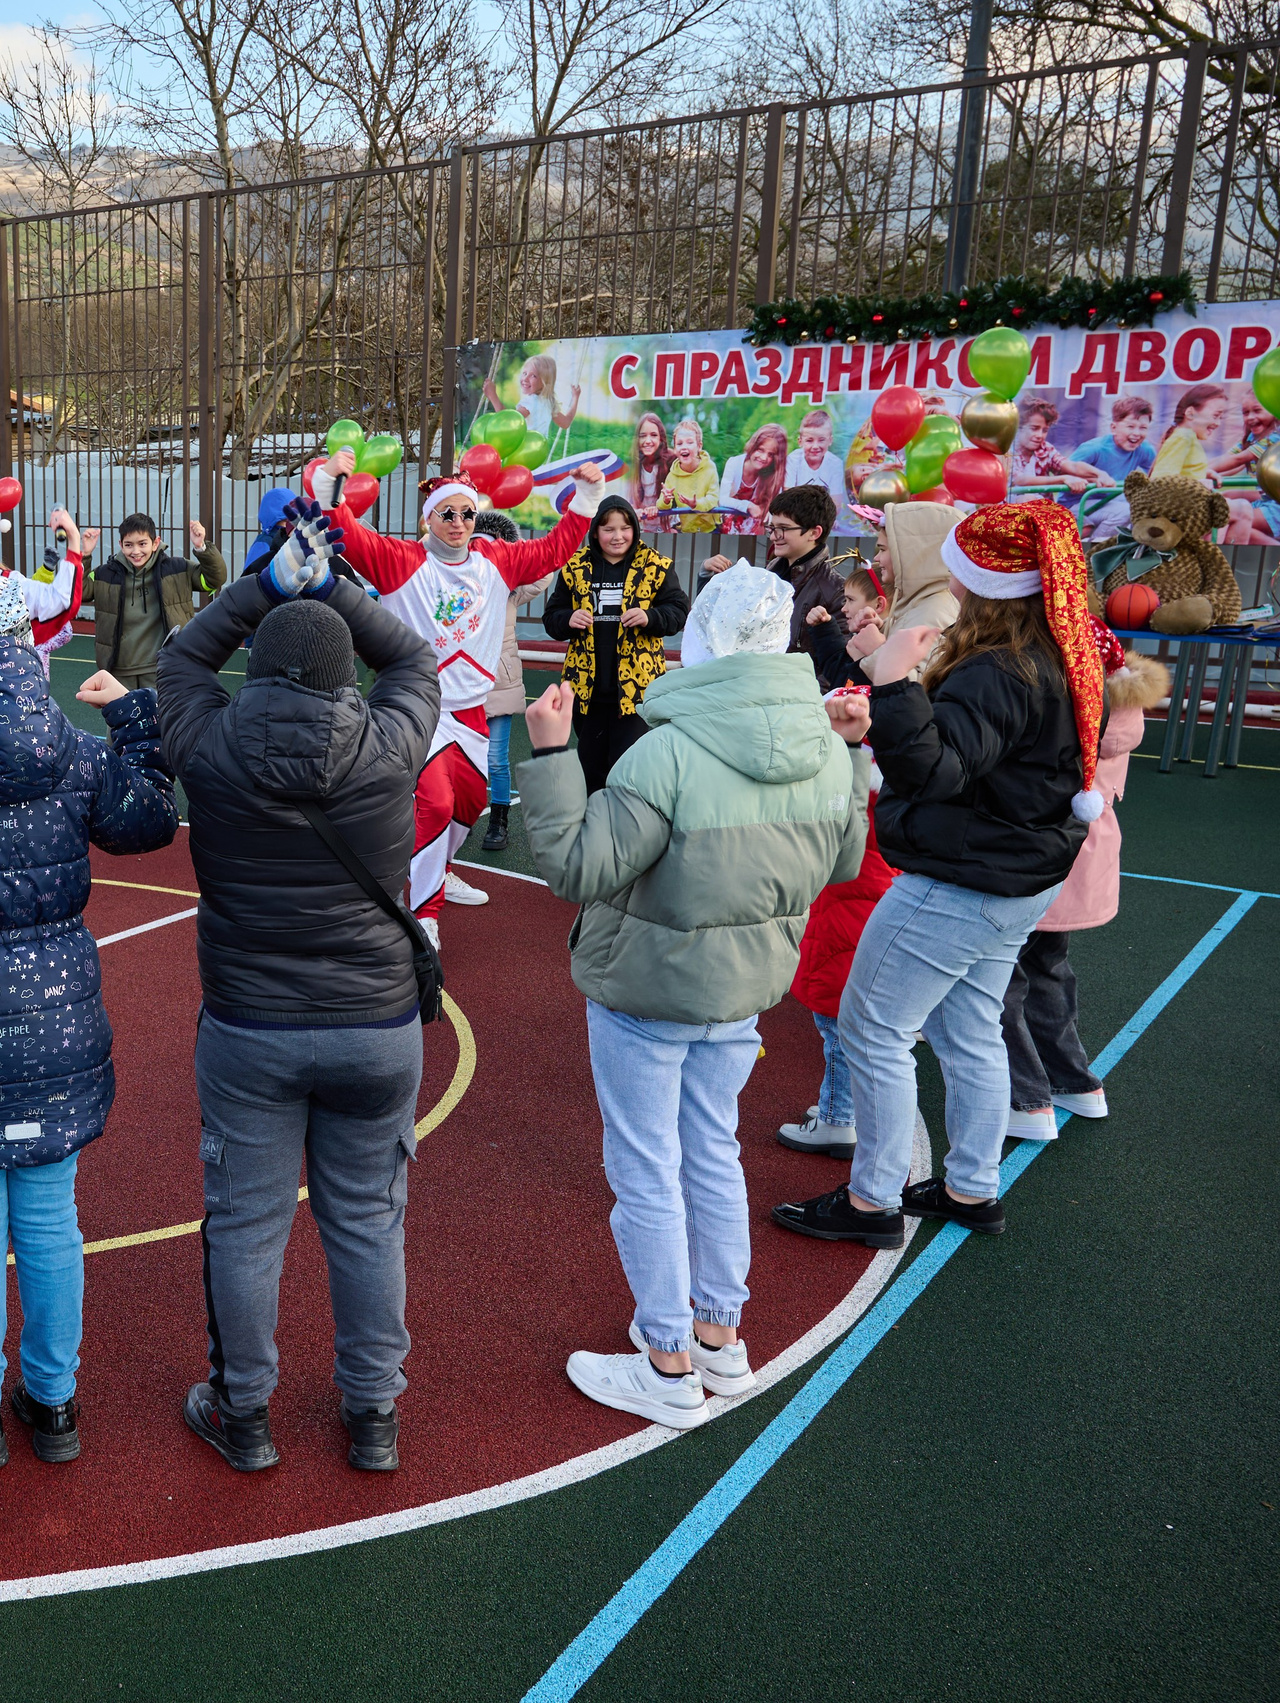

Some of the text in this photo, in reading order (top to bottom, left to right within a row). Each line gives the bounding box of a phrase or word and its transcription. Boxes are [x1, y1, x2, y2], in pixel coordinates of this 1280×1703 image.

[610, 354, 639, 399] С
[1069, 326, 1280, 396] ДВОР
[44, 984, 67, 999] DANCE
[9, 1024, 30, 1037] FREE
[63, 1025, 76, 1037] PARTY
[48, 1090, 71, 1103] DANCE
[65, 1129, 78, 1140] PARTY
